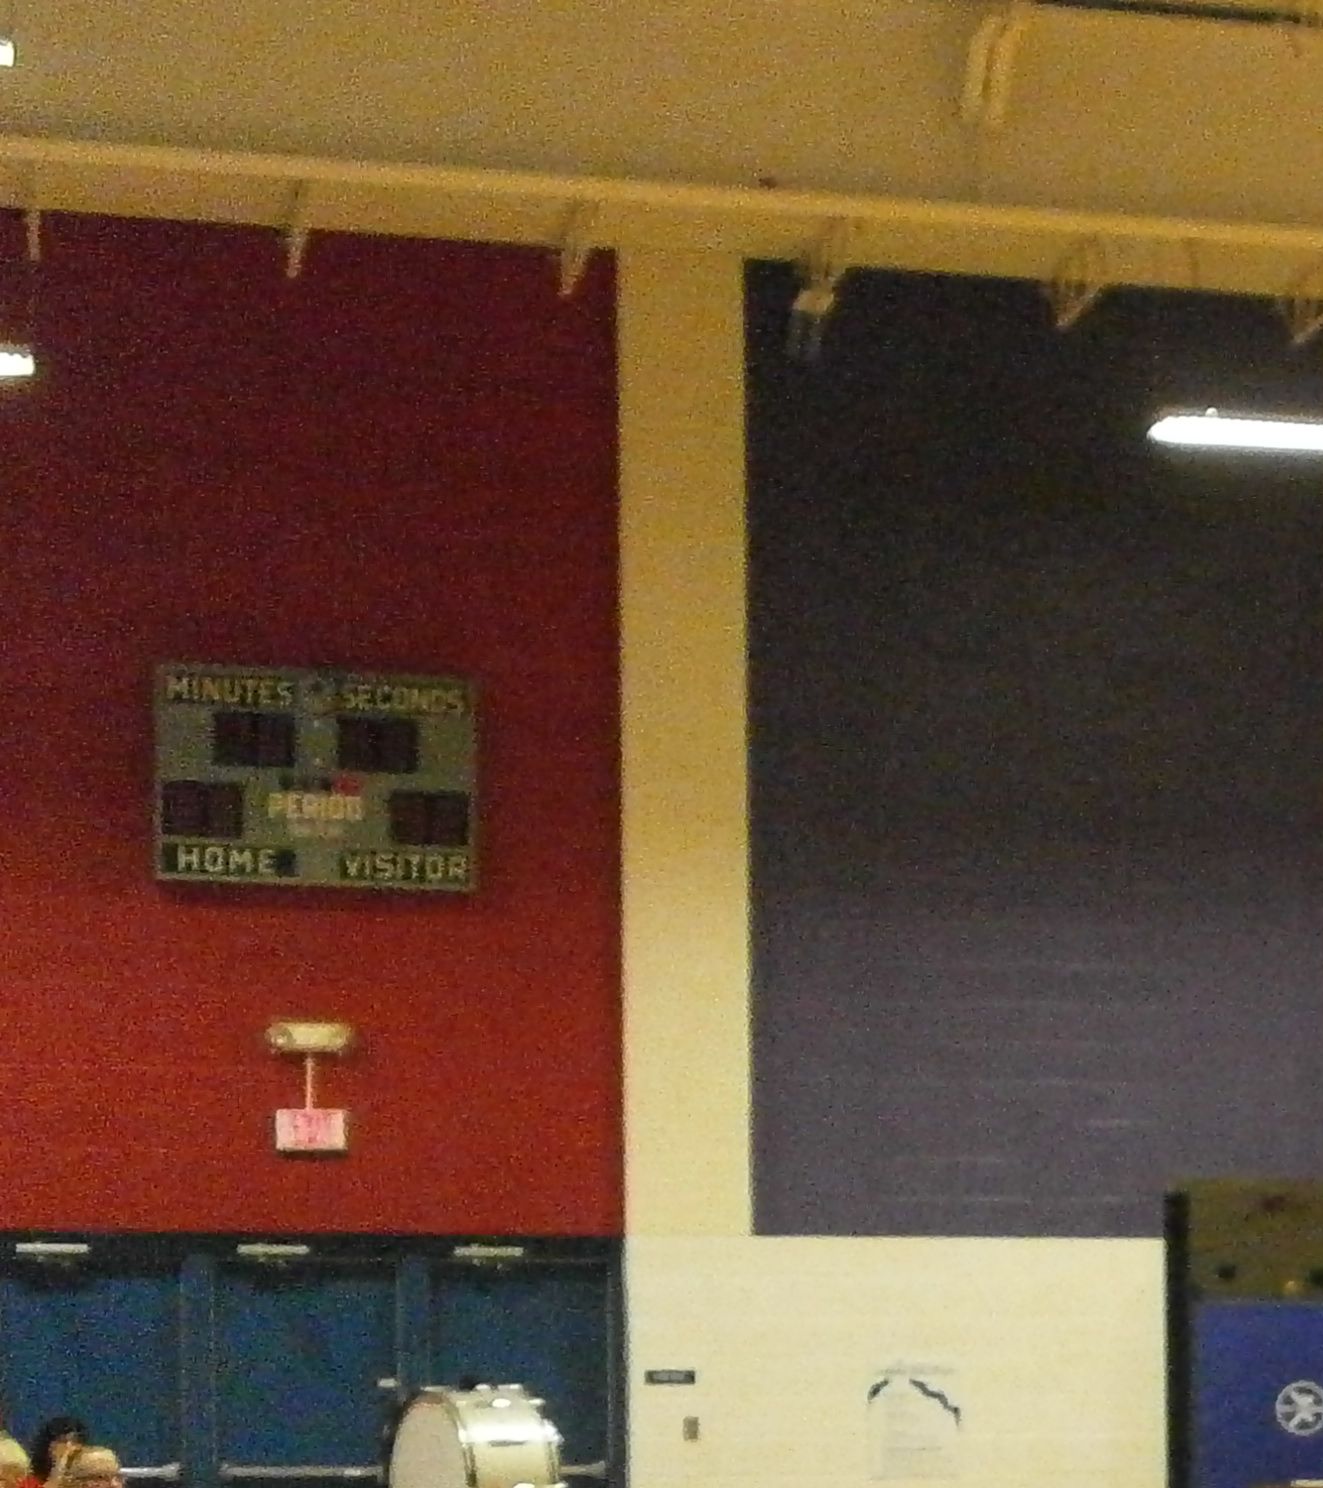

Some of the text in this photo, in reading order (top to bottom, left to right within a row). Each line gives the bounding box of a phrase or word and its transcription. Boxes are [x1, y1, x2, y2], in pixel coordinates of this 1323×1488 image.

[166, 677, 293, 705] MINUTES
[343, 683, 464, 713] SECONDS
[177, 846, 278, 875] HOME
[344, 852, 467, 881] VISITOR
